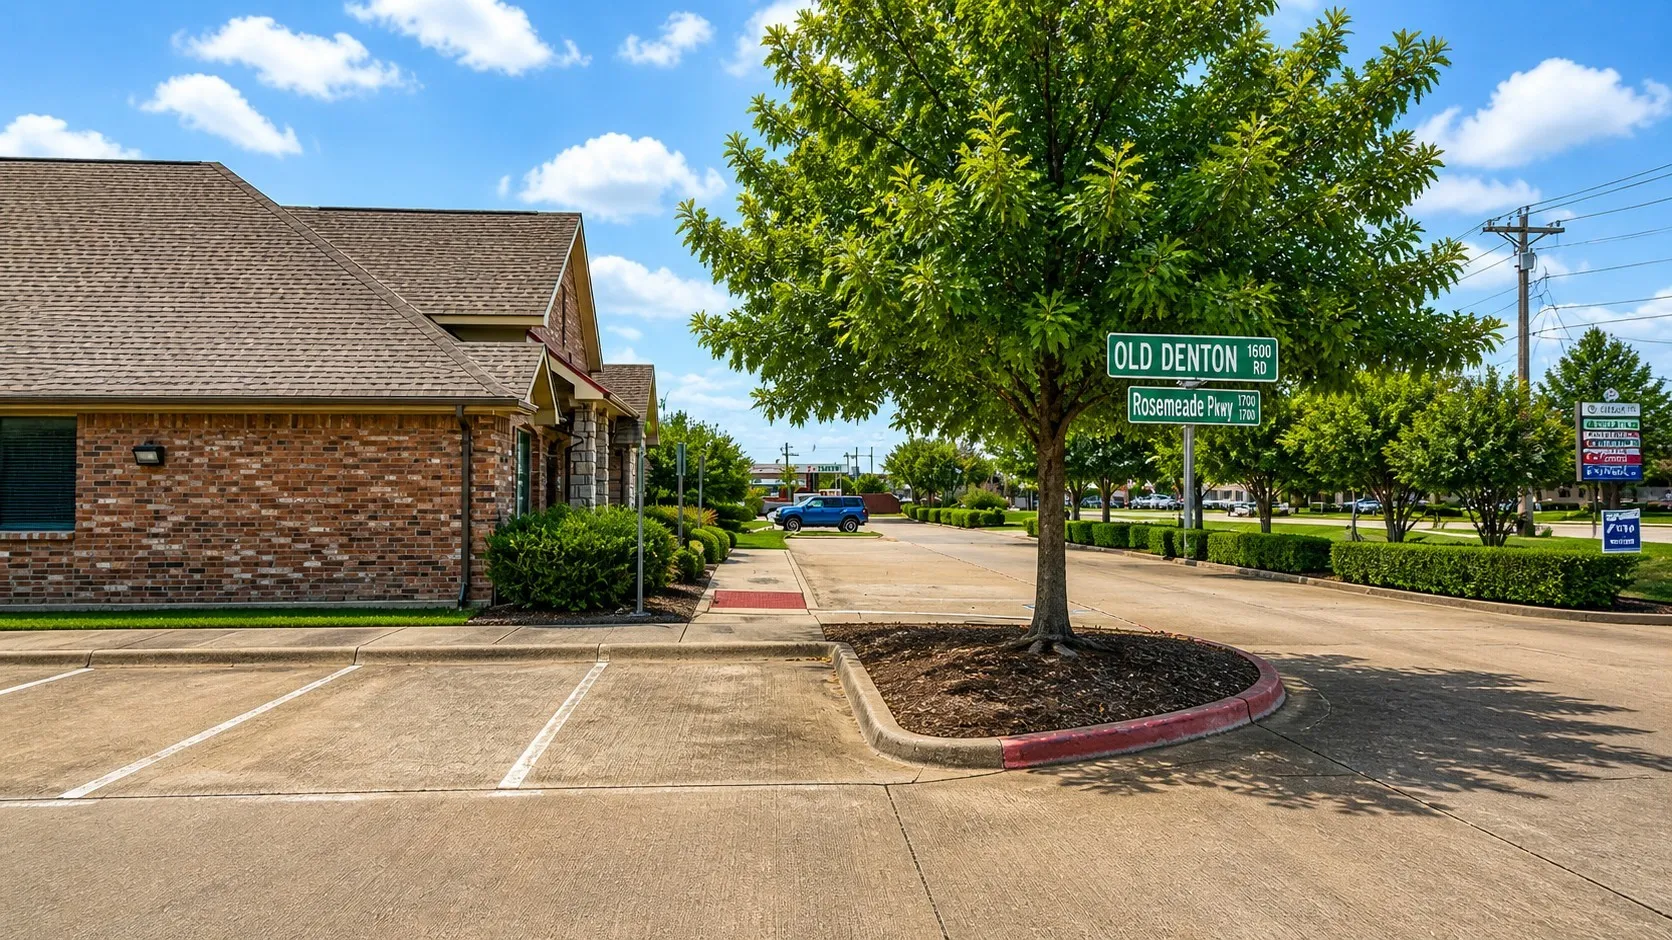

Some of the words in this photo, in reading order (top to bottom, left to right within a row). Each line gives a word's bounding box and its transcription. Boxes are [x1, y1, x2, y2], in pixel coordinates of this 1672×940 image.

[1115, 341, 1153, 370] OLD
[1161, 342, 1237, 373] DENTON
[1247, 344, 1272, 358] 1600
[1253, 361, 1267, 375] RD
[1133, 392, 1204, 417] Rosemeade
[1207, 395, 1234, 422] Pkwy
[1238, 395, 1256, 407] 1700
